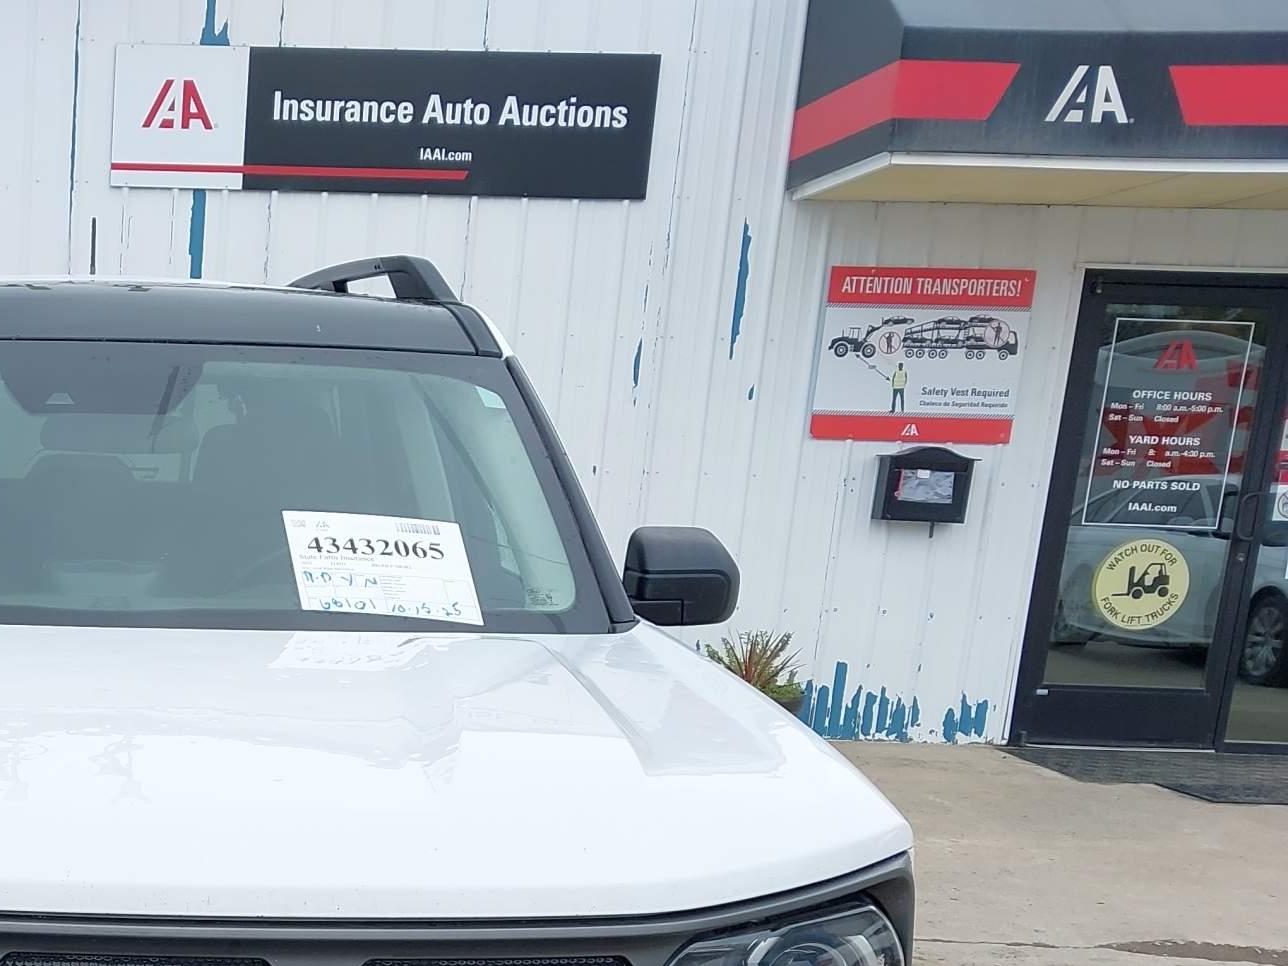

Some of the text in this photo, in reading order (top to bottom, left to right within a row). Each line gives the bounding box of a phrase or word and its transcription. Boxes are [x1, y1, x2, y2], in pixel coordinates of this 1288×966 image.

[272, 90, 629, 130] Insurance Auto Auctions
[419, 147, 473, 162] IAAI.com
[841, 275, 1023, 297] ATTENTION TRANSPORTERS!
[921, 386, 1010, 399] Safety Vest Required
[1132, 389, 1213, 401] OFFICE HOURS
[1110, 402, 1128, 410] Mon
[1134, 402, 1145, 410] Fri
[1128, 414, 1143, 422] Sun
[1154, 415, 1179, 423] Closed
[1128, 435, 1201, 446] YARD HOURS
[1102, 447, 1120, 455] Mon
[1126, 448, 1137, 456] Fri
[1120, 459, 1135, 467] Sun
[1146, 460, 1172, 468] Closed
[1112, 479, 1201, 491] NO PARTS SOLD
[1127, 502, 1177, 513] IAAI.com
[307, 536, 445, 560] 43432065
[1106, 543, 1178, 571] WATCH OUT FOR
[1100, 592, 1179, 625] FORK LIFT TRUCKS
